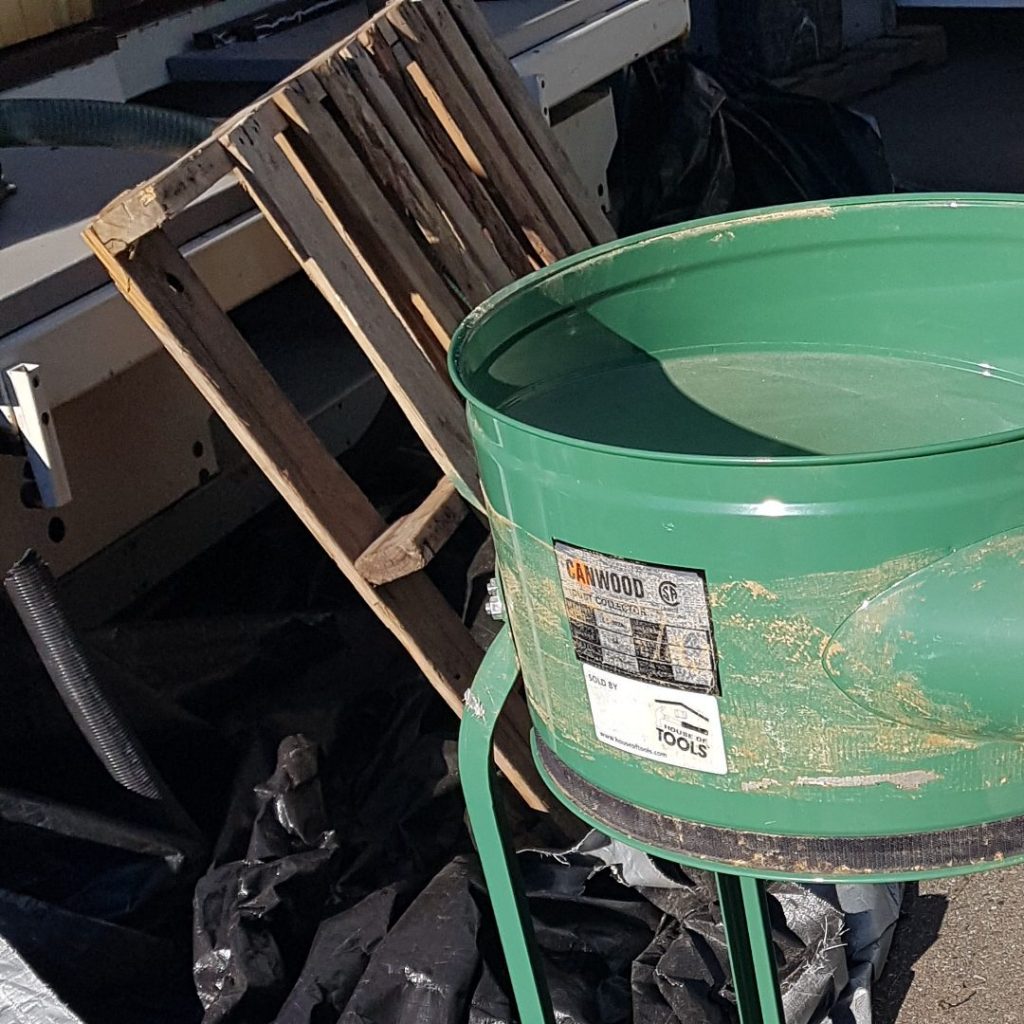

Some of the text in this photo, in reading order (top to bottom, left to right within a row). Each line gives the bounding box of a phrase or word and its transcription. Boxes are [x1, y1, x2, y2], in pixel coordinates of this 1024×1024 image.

[566, 559, 645, 598] CANWOOD
[588, 673, 618, 691] SOLD BY
[656, 728, 708, 758] TOOLS
[664, 724, 707, 744] HOUSE OF
